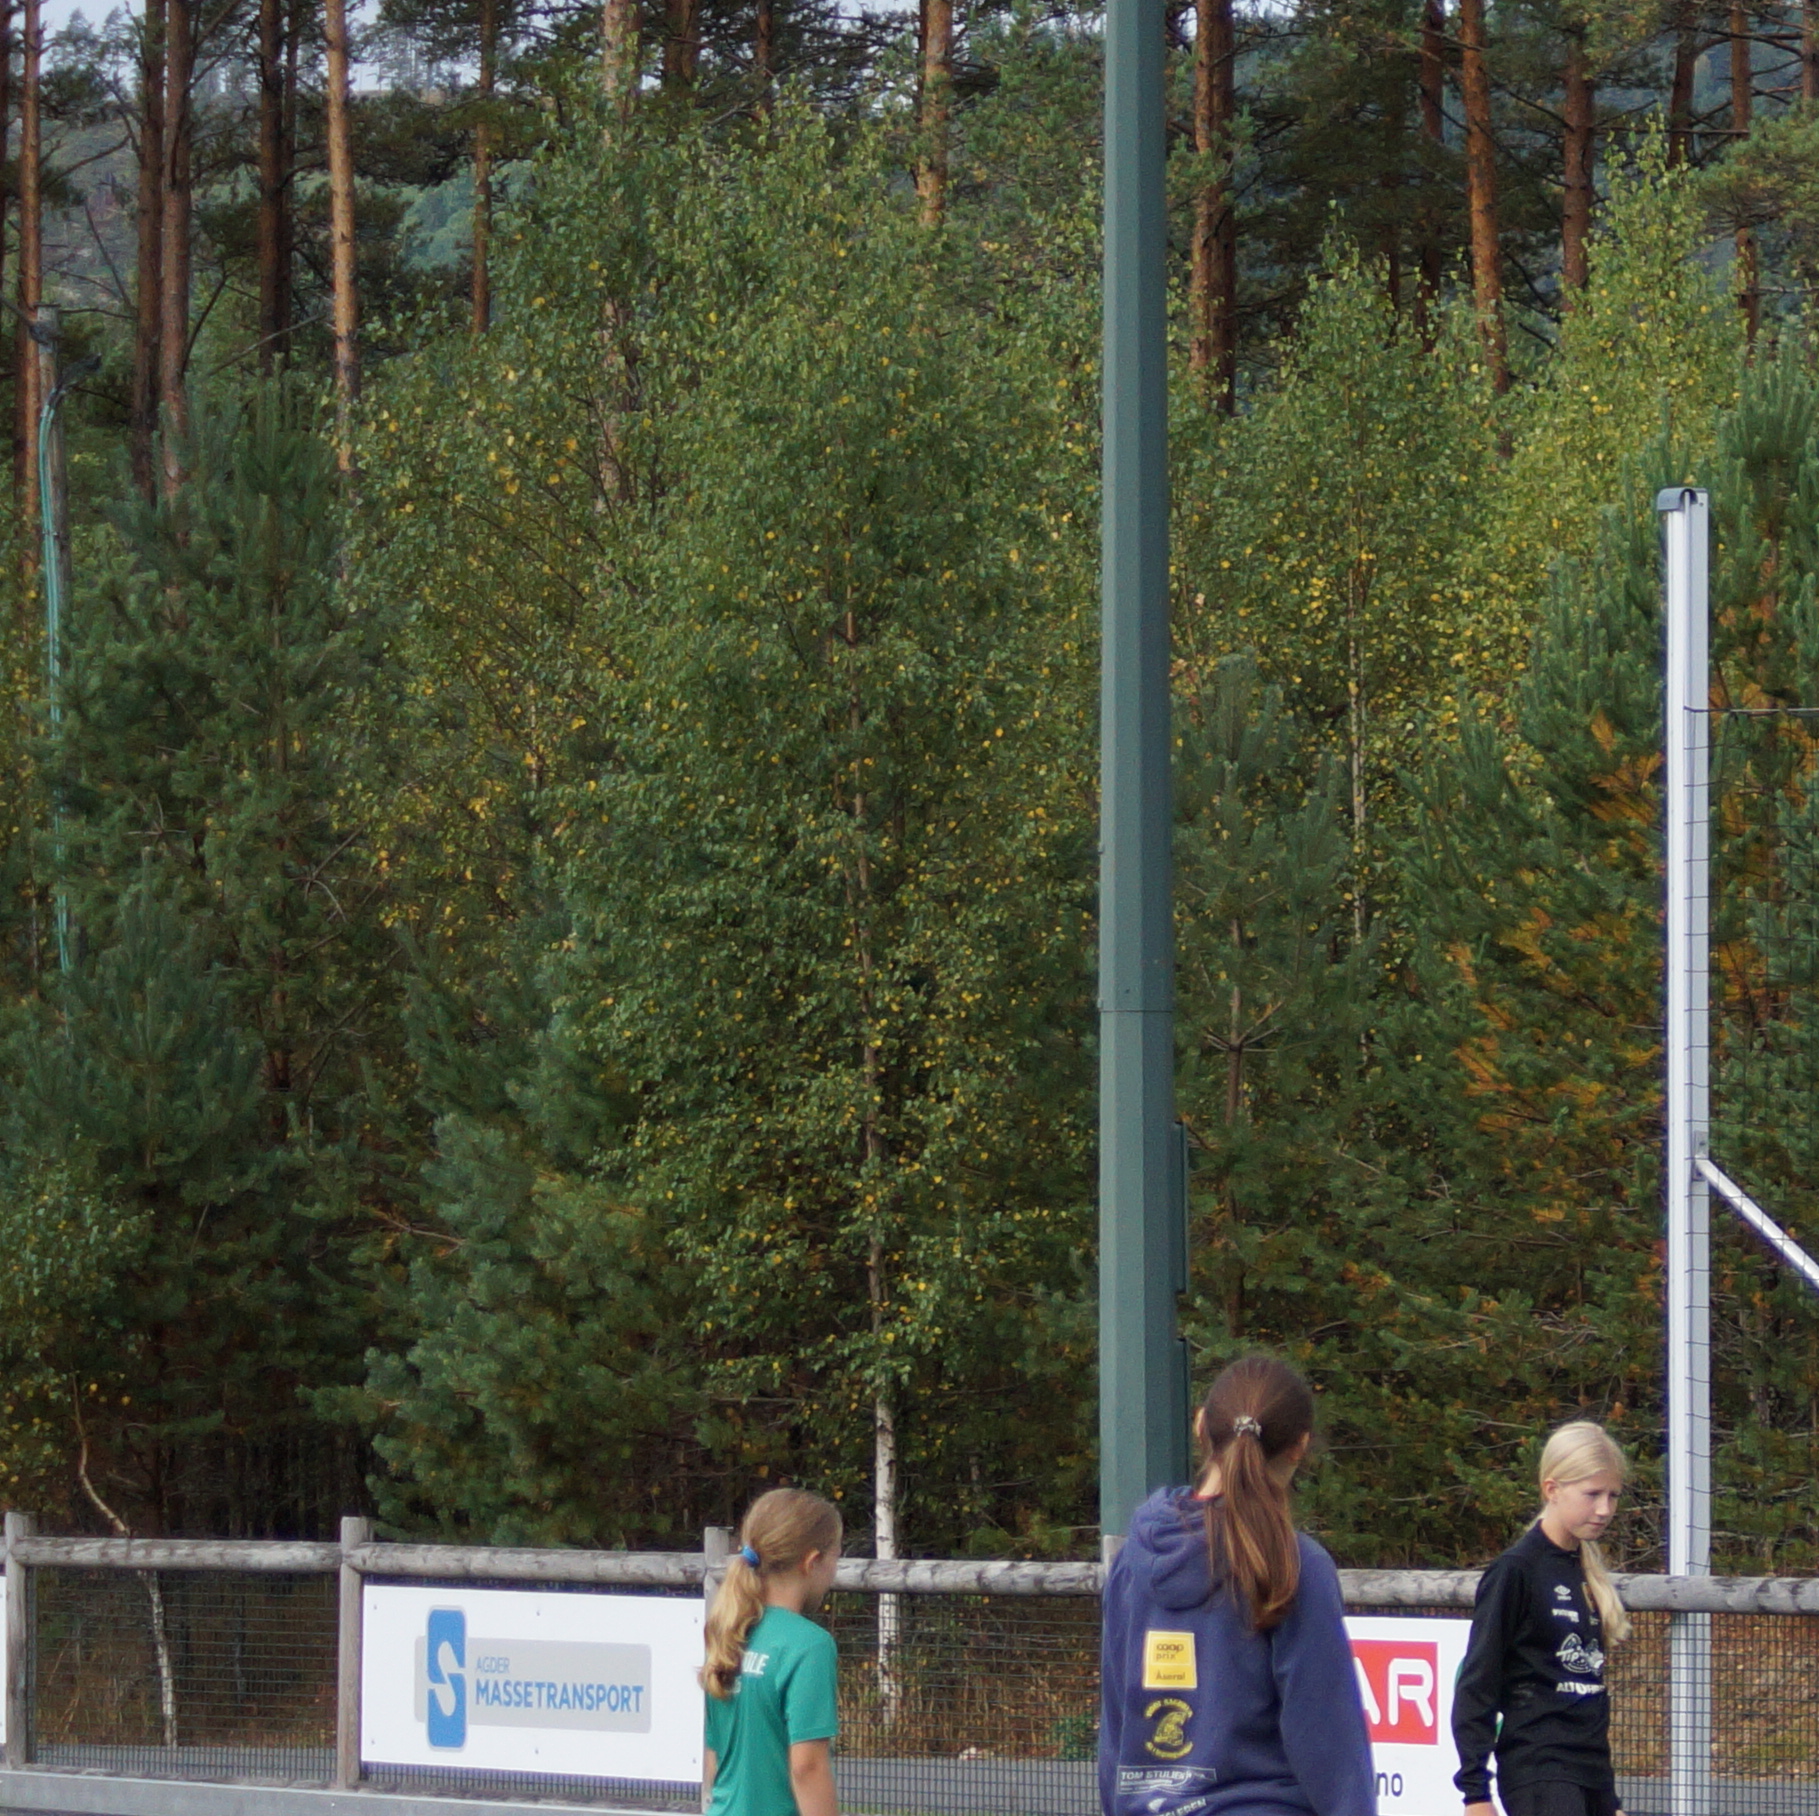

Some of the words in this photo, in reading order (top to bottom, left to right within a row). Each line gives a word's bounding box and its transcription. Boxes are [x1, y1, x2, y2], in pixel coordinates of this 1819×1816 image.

[1156, 1643, 1185, 1653] coop
[1156, 1653, 1176, 1661] prix
[475, 1656, 510, 1673] AGDER
[475, 1678, 644, 1713] MASSETRANSPORT
